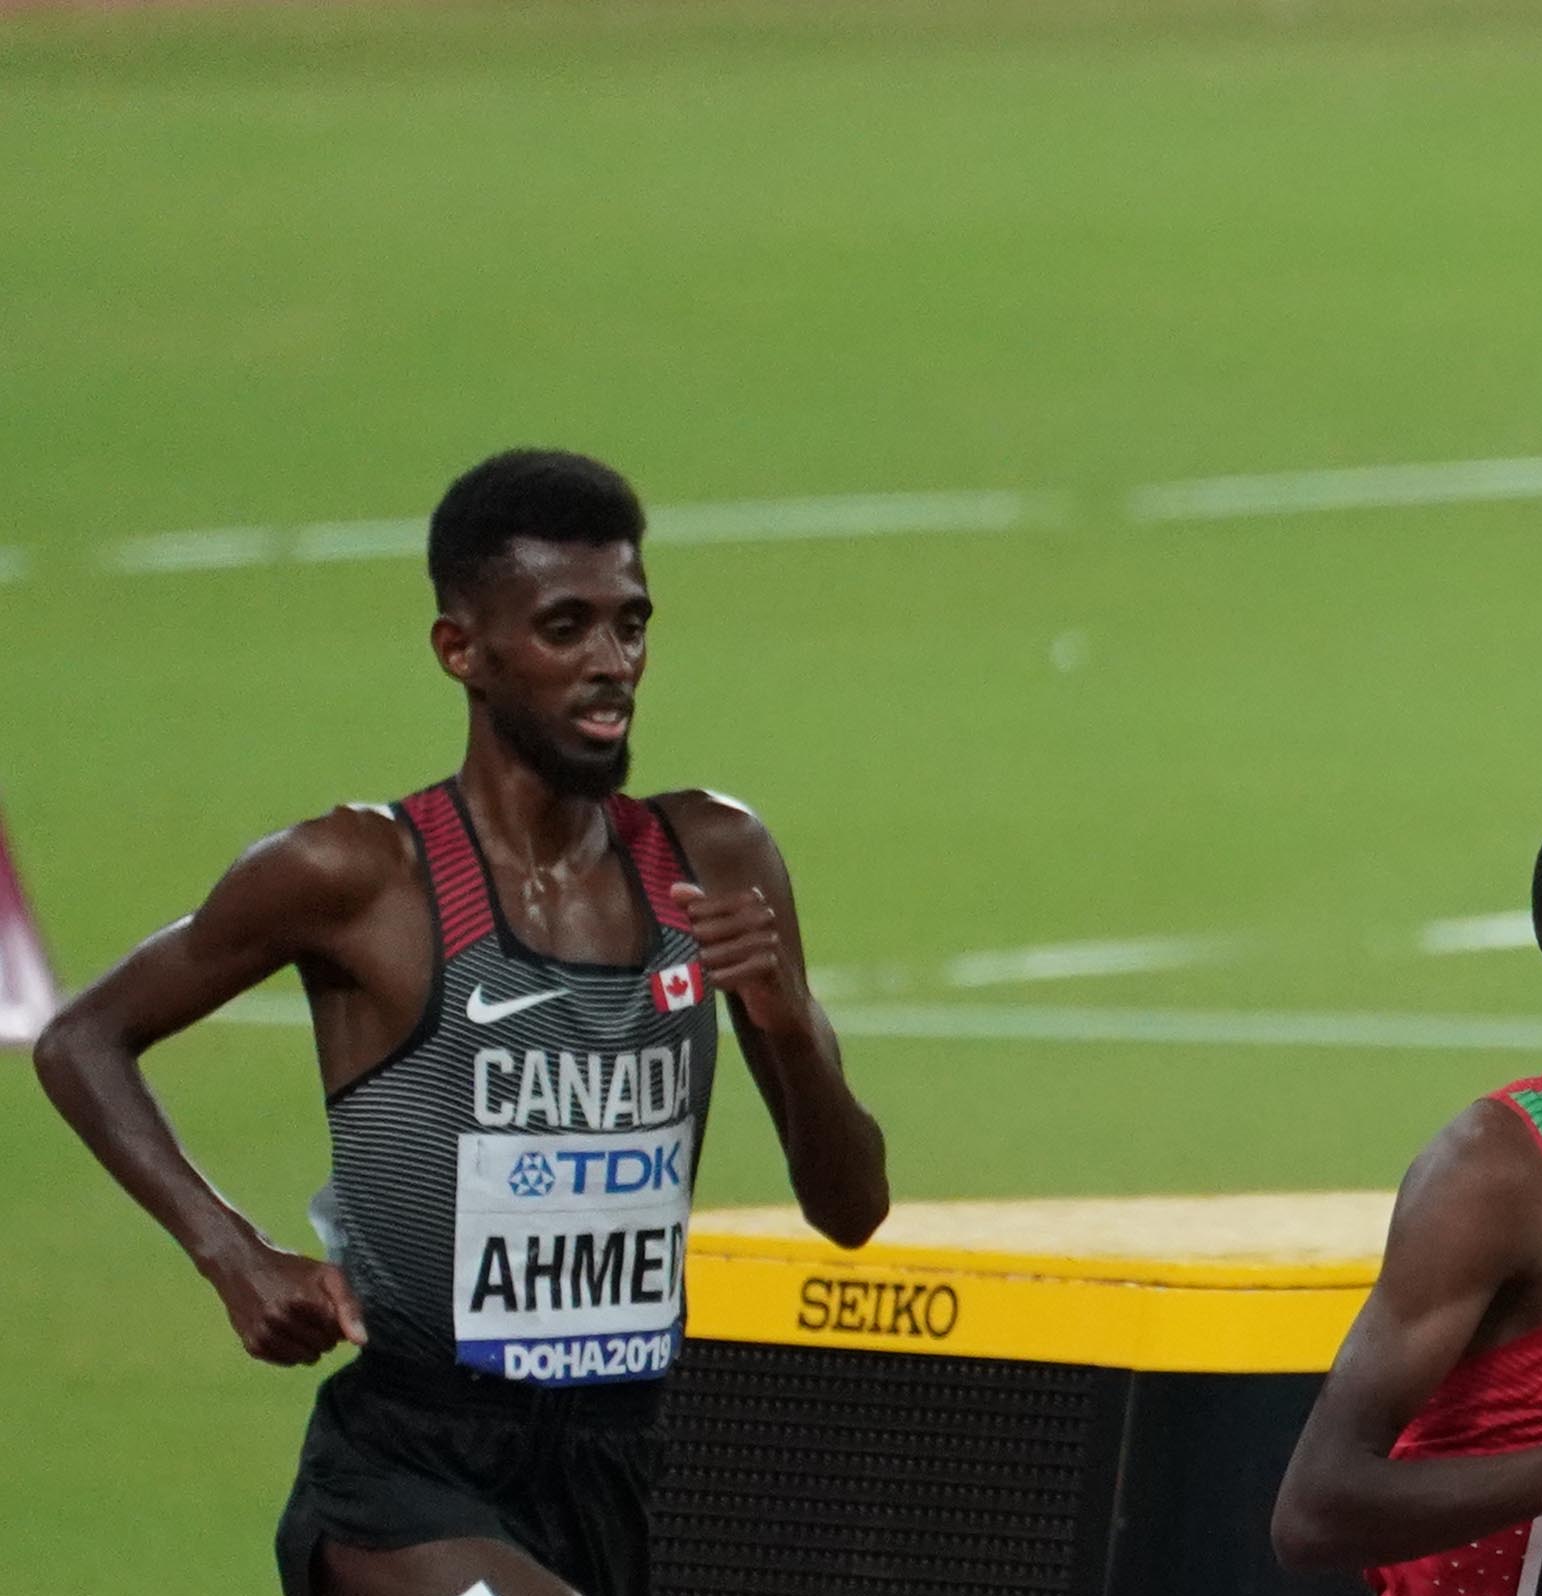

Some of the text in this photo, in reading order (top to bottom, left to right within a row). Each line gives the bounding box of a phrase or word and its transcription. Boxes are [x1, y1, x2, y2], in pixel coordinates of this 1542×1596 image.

[473, 1040, 691, 1127] CANADA
[556, 1141, 681, 1195] TDK
[797, 1277, 959, 1339] SEIKO
[504, 1331, 672, 1380] DOHA2019
